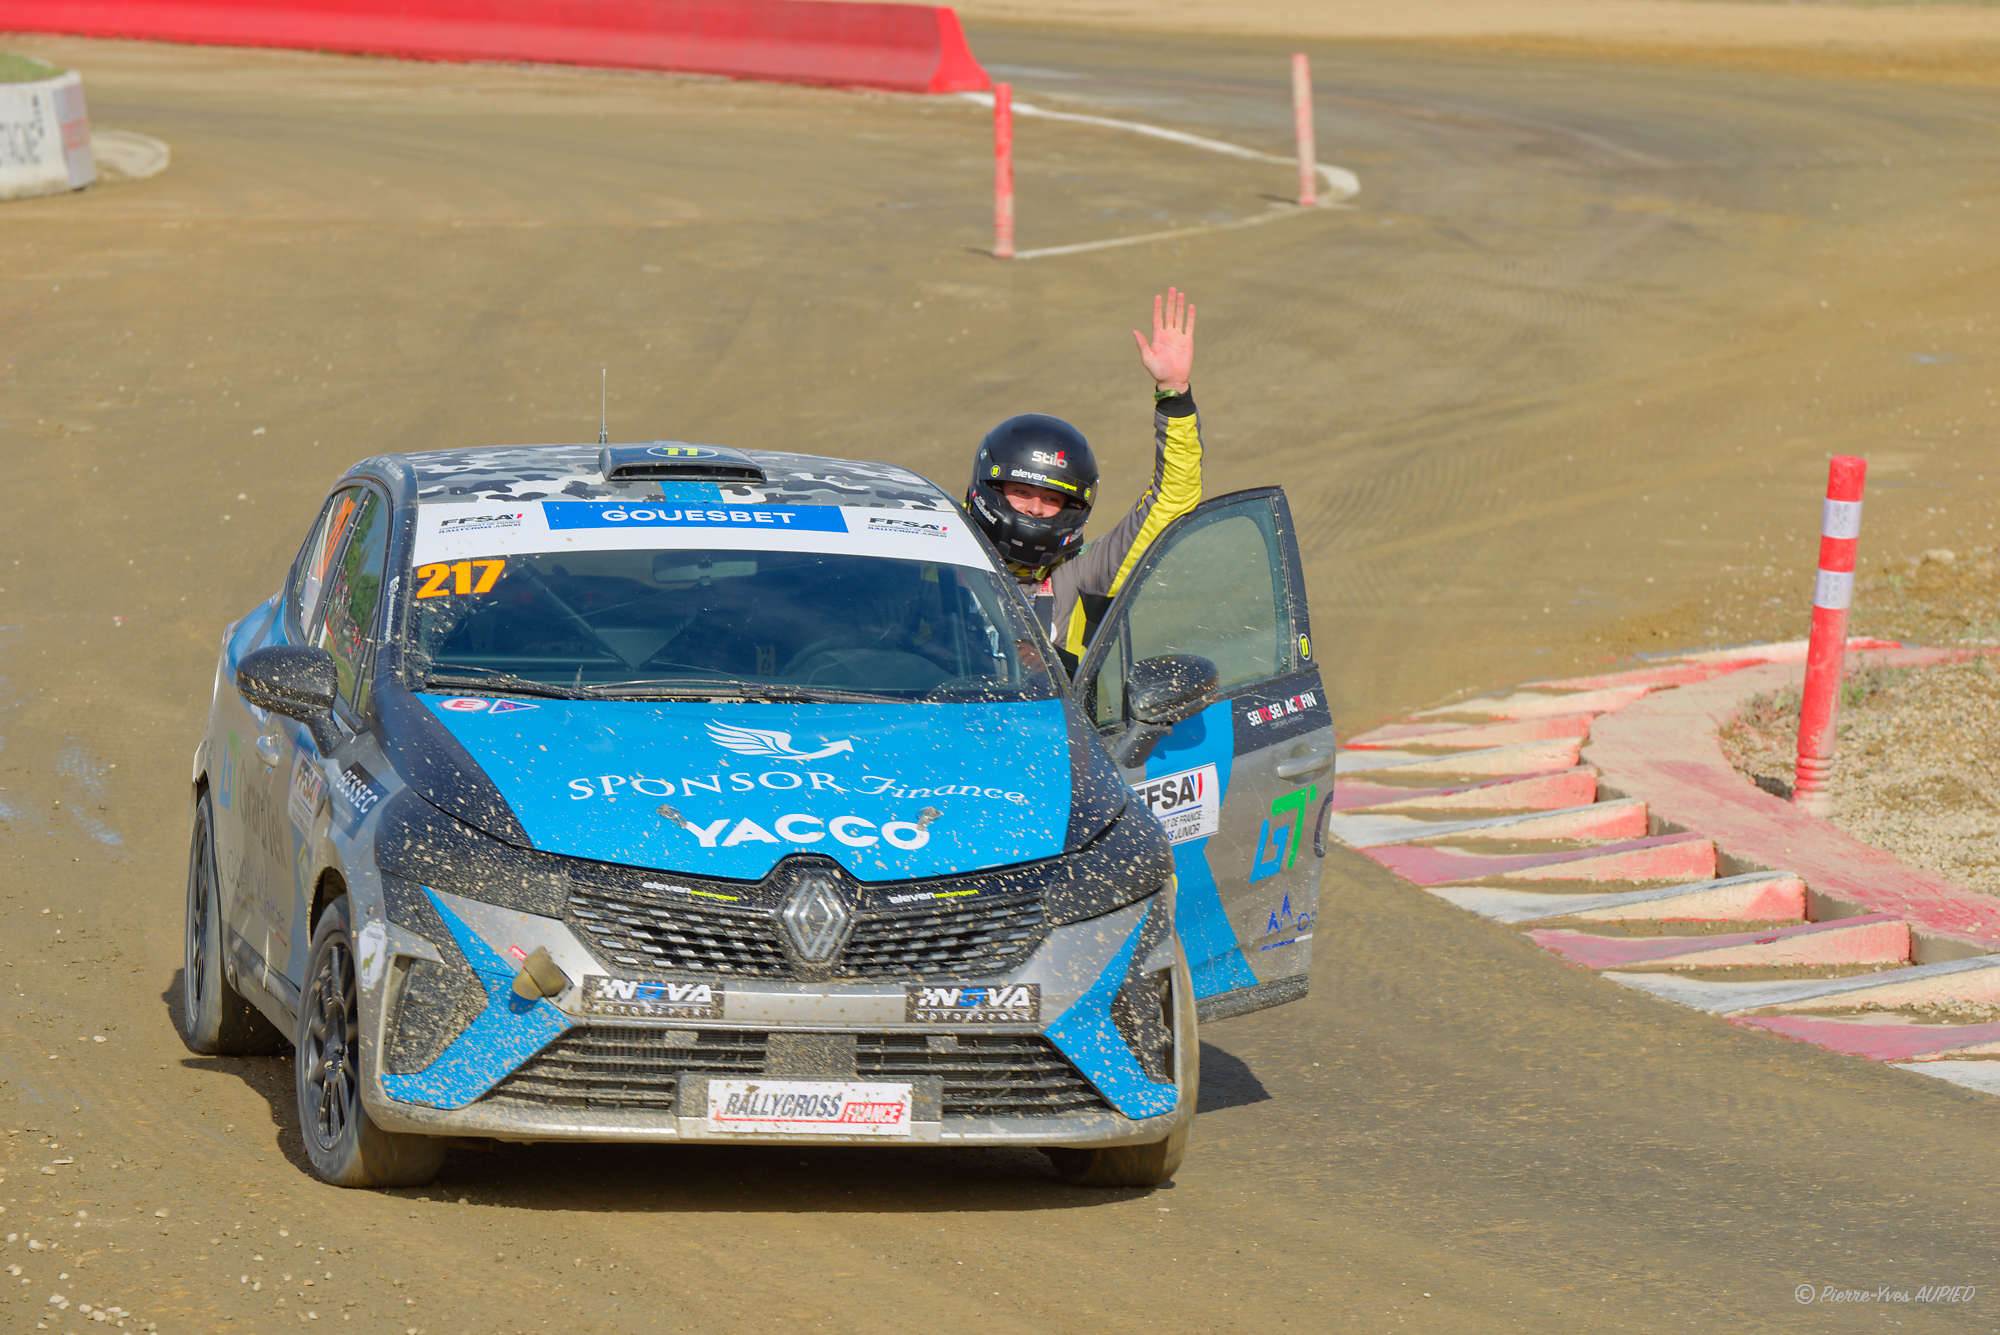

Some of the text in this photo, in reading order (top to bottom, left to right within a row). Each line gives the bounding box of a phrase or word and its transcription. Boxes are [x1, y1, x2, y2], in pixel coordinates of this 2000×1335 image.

[1031, 450, 1068, 469] Stilo
[601, 509, 796, 524] GOUESBET
[416, 560, 506, 599] 217
[335, 769, 379, 814] BESSEC
[568, 771, 1025, 802] SPONSOR Finance
[686, 814, 930, 850] YACCO
[725, 1093, 902, 1123] RALLYCROSS FRANCE
